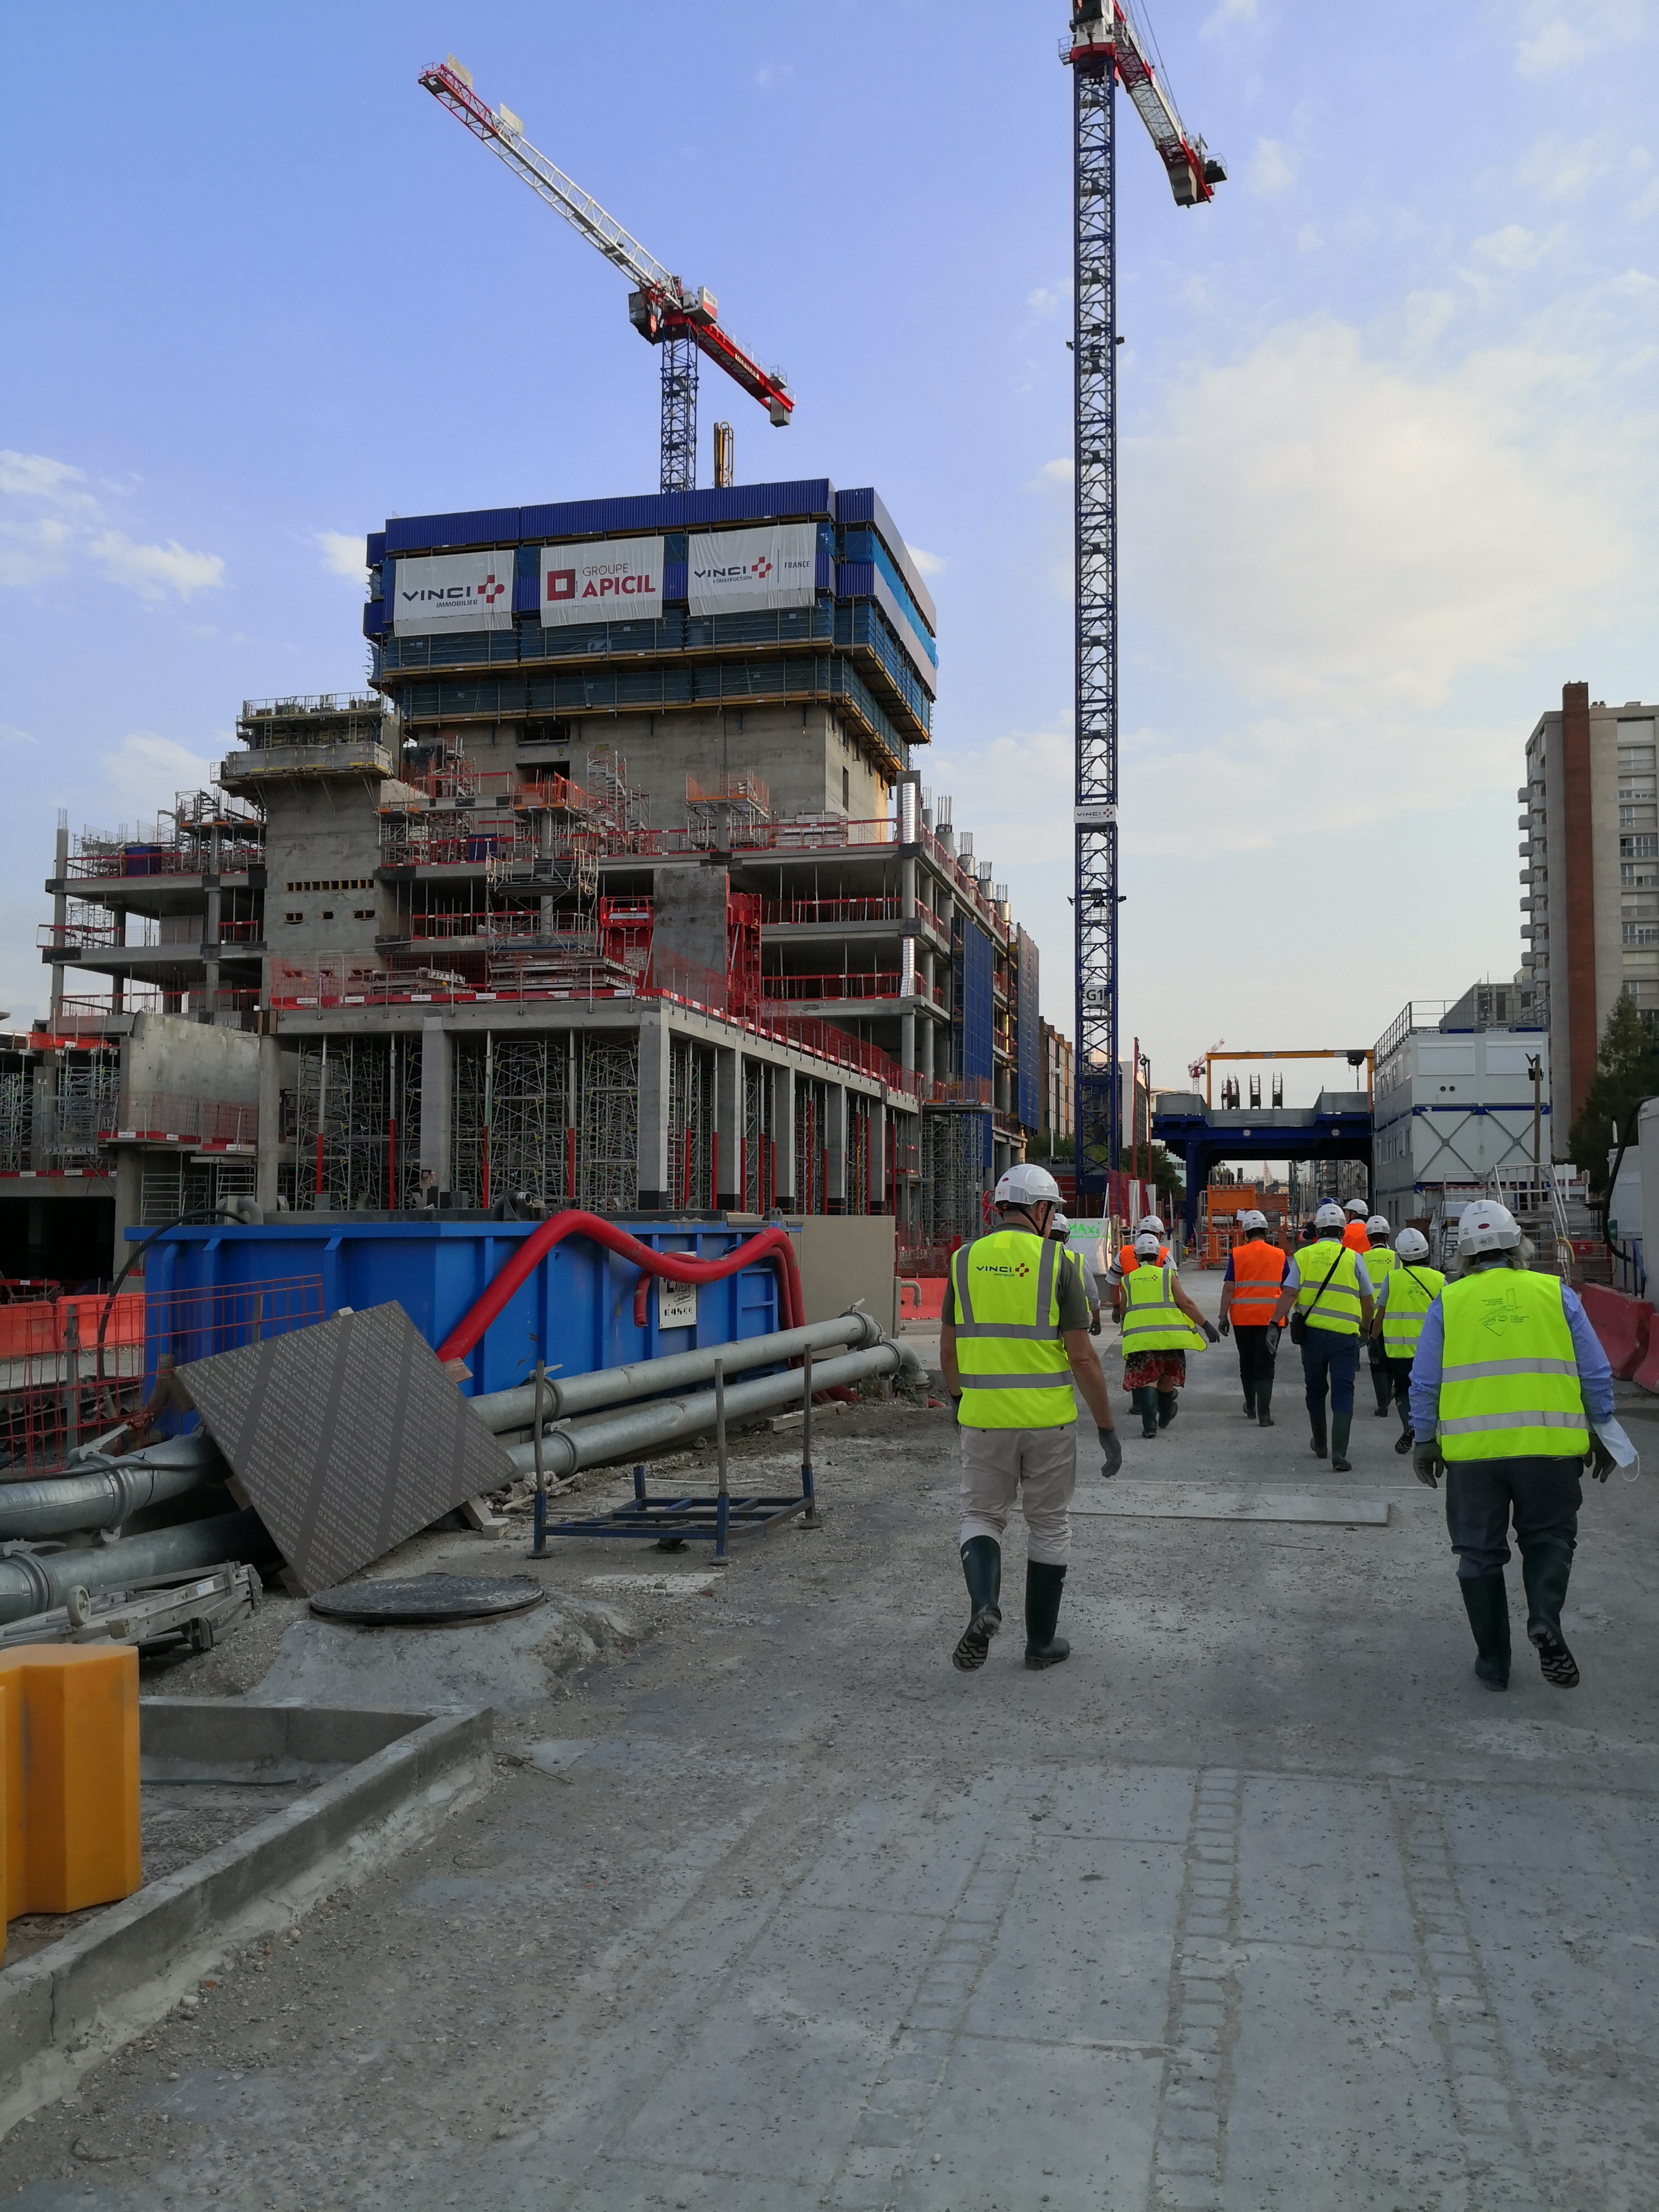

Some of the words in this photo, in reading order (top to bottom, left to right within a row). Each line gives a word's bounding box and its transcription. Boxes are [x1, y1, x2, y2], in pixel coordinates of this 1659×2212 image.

[583, 563, 629, 576] GROUPE
[784, 561, 810, 569] FRANCE
[693, 566, 746, 578] VINCI
[713, 575, 753, 584] CONSTRUCTION
[581, 575, 656, 598] APICIL
[402, 586, 470, 601] VINCI
[436, 599, 478, 608] IMMOBILIER
[1086, 989, 1103, 1001] G1
